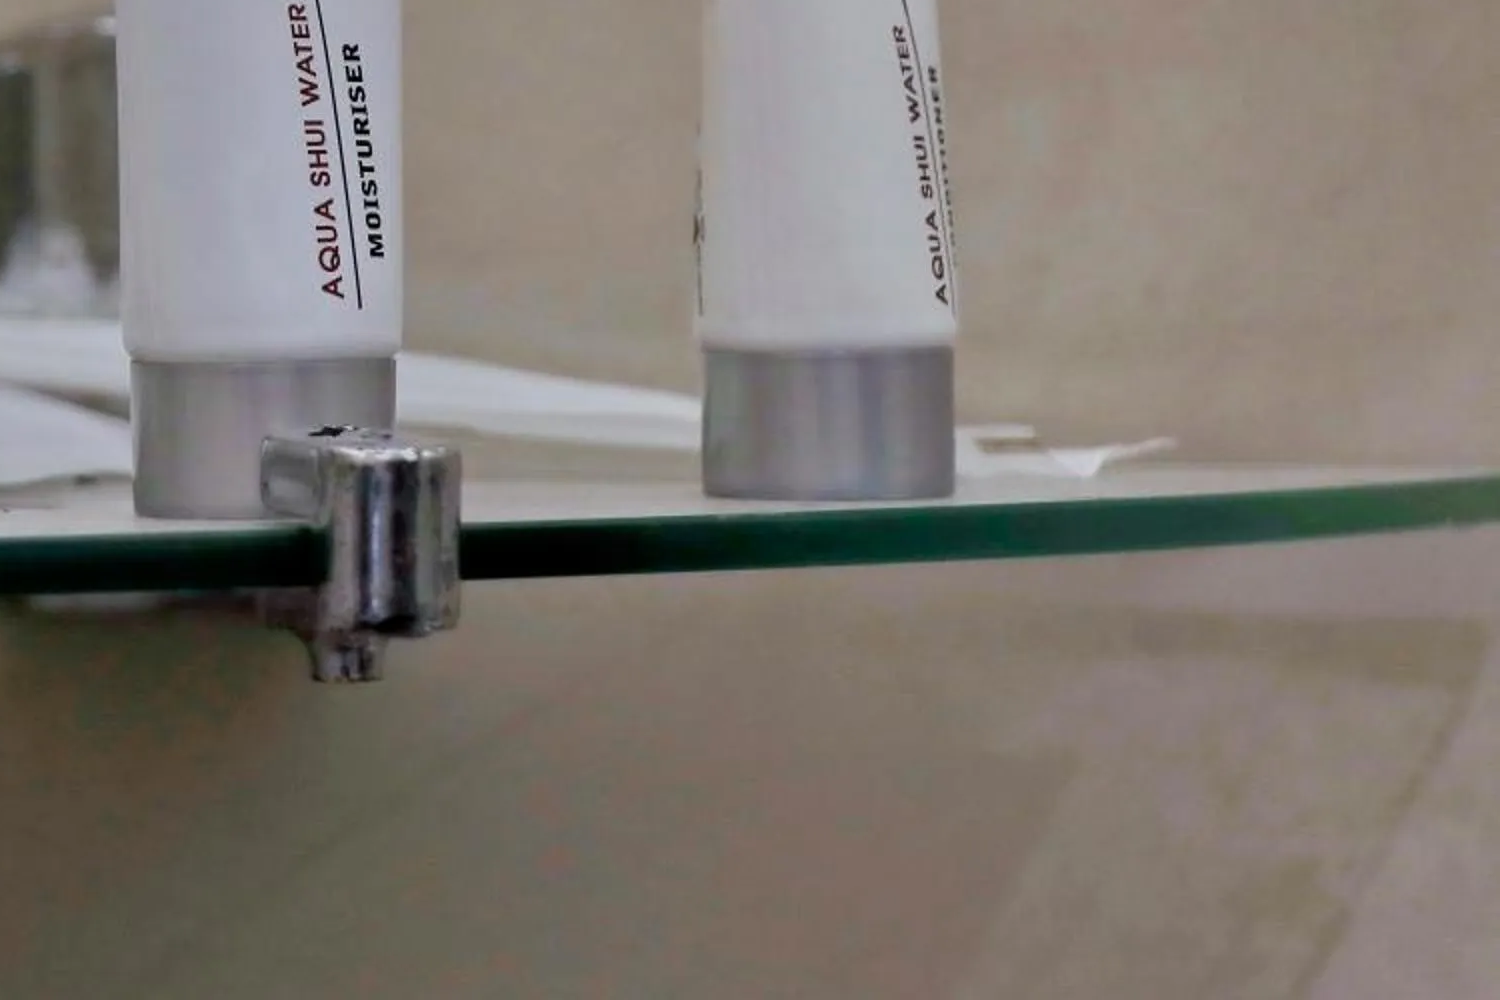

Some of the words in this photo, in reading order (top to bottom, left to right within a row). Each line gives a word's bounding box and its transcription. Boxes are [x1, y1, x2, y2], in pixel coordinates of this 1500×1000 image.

[288, 3, 321, 107] WATER
[893, 25, 921, 124] WATER
[304, 119, 331, 187] SHUI
[342, 43, 385, 259] MOISTURISER
[913, 135, 933, 200] SHUI
[313, 198, 345, 299] AQUA
[925, 210, 949, 305] AQUA
